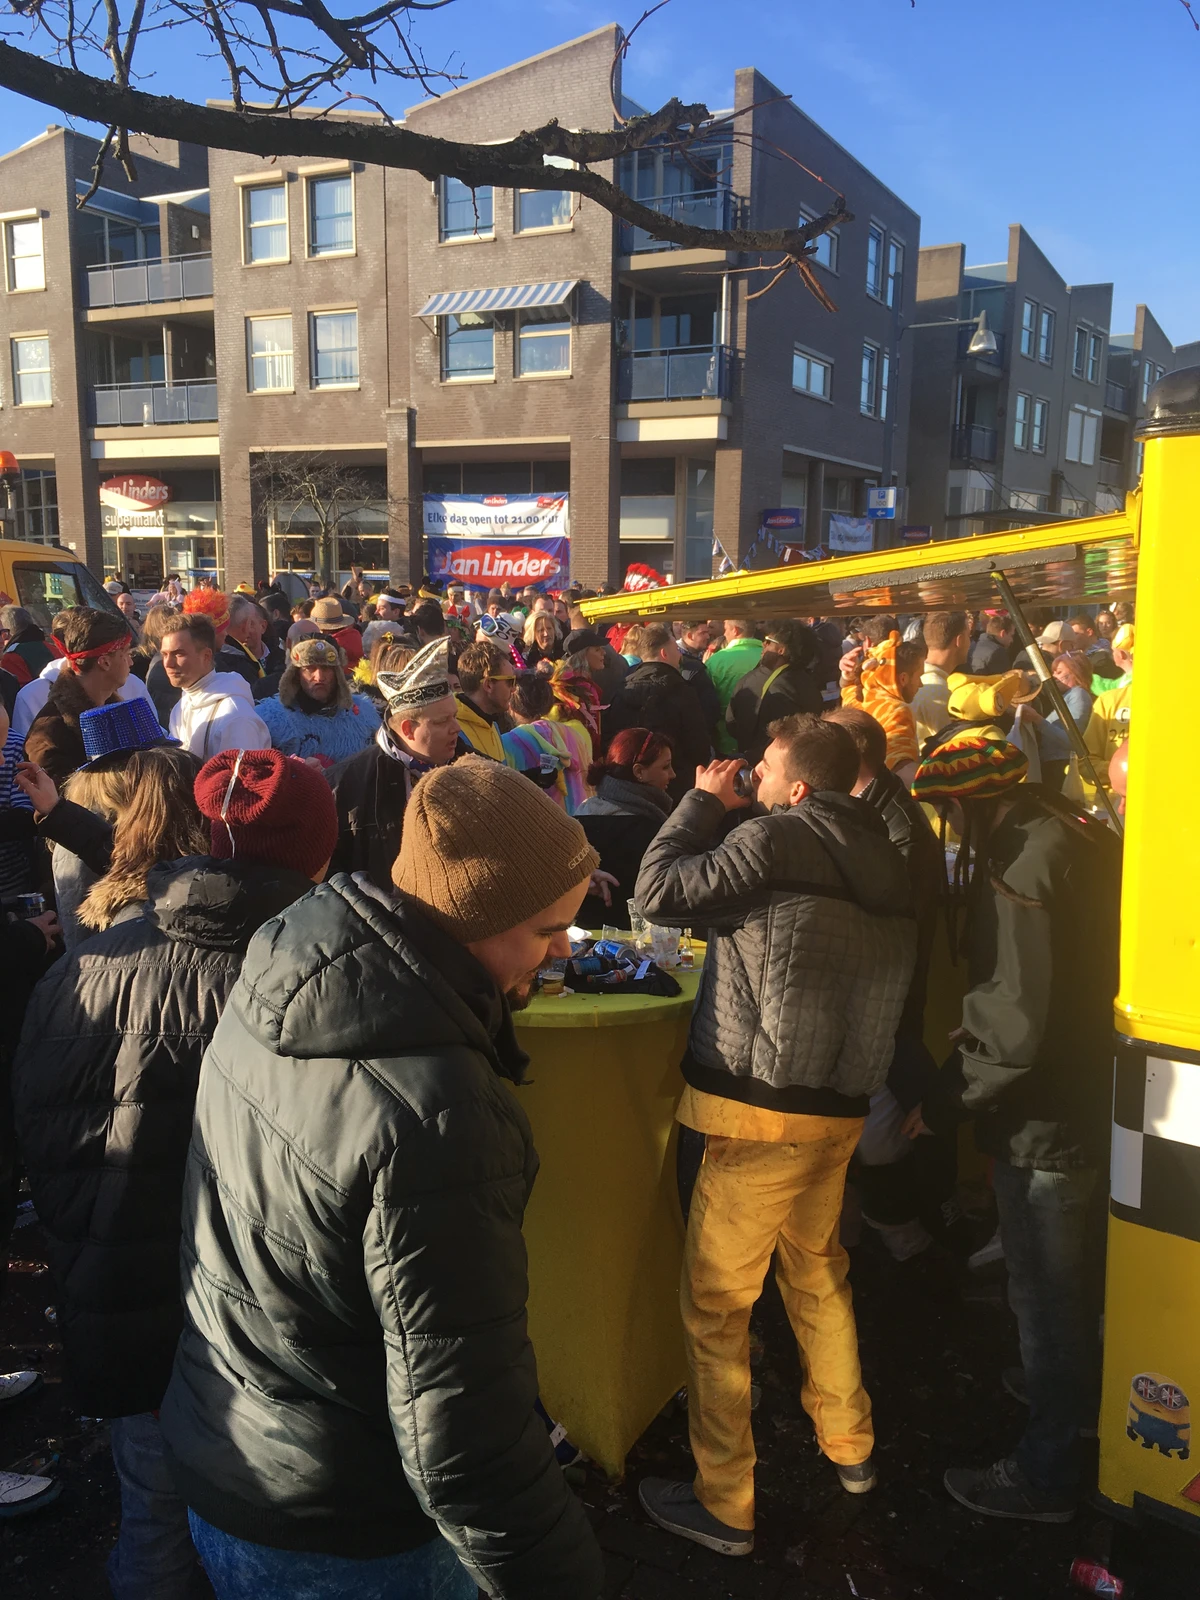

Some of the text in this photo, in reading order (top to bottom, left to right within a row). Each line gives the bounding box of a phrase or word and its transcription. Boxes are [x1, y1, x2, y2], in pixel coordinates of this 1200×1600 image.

[105, 510, 164, 528] supermarkt
[427, 512, 447, 523] Elke
[450, 513, 468, 526] dag
[469, 516, 491, 526] open
[494, 515, 508, 524] tot
[511, 515, 540, 524] 21.00
